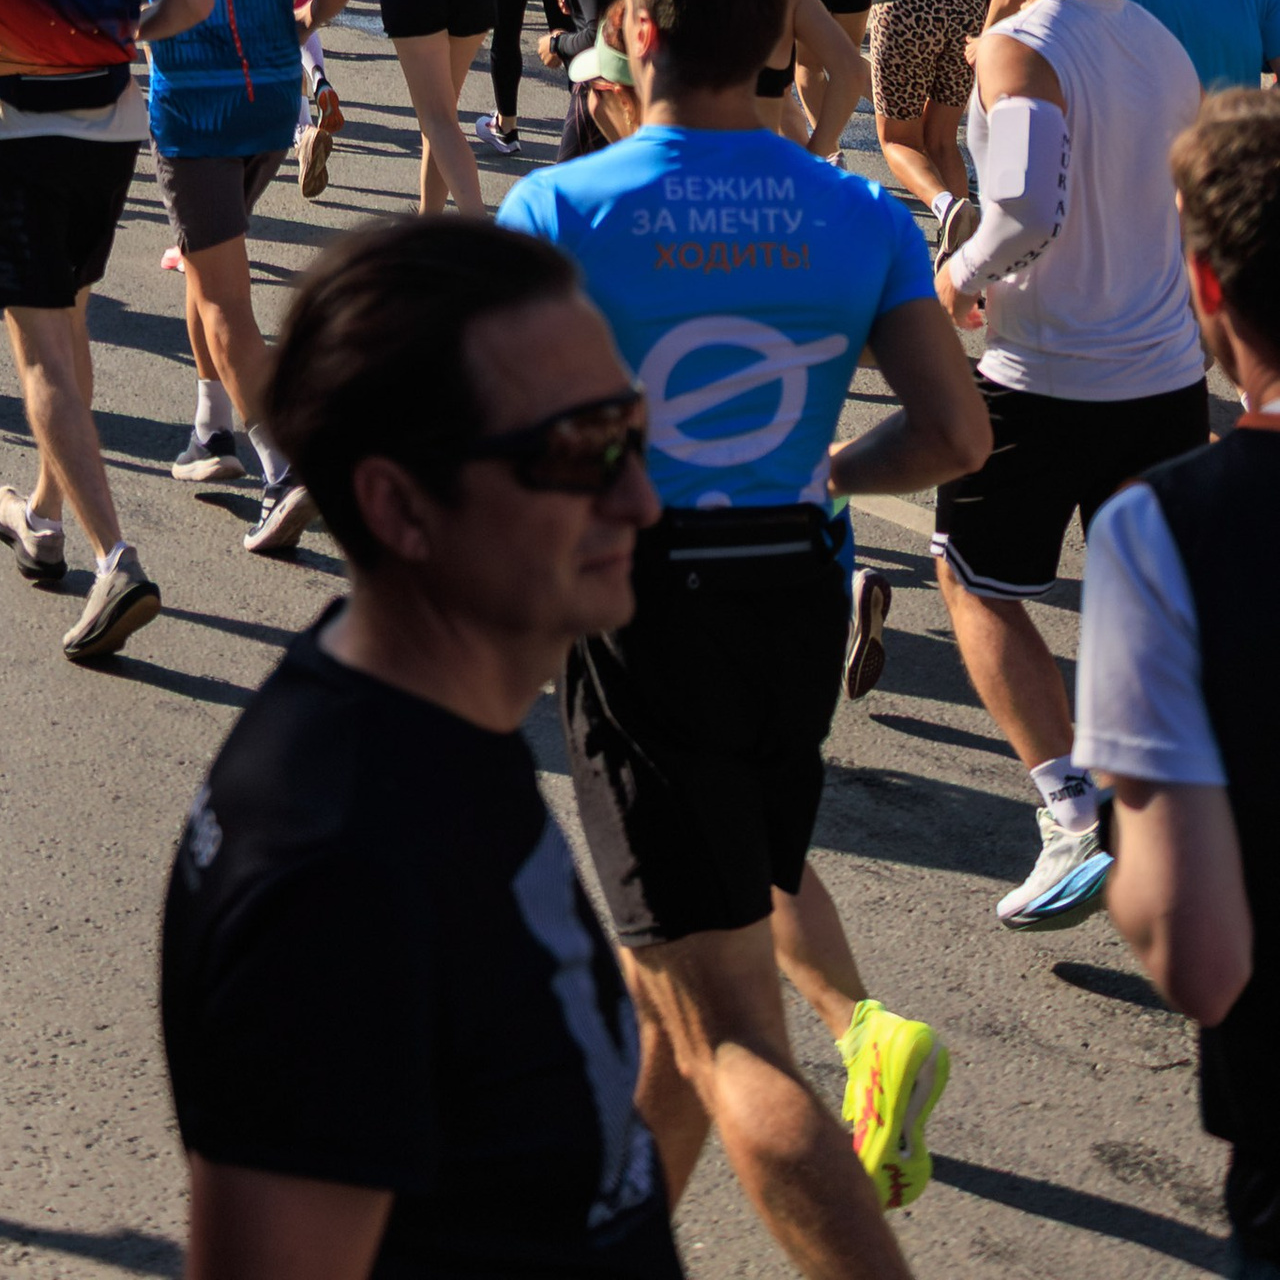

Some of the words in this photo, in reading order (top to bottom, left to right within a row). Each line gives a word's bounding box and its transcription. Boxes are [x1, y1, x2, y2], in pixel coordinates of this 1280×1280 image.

[664, 175, 796, 202] БЕЖИМ
[631, 207, 677, 236] ЗА
[688, 206, 804, 235] МЕЧТУ
[654, 240, 811, 275] ХОДИТЬ!
[1048, 782, 1086, 804] PUMA
